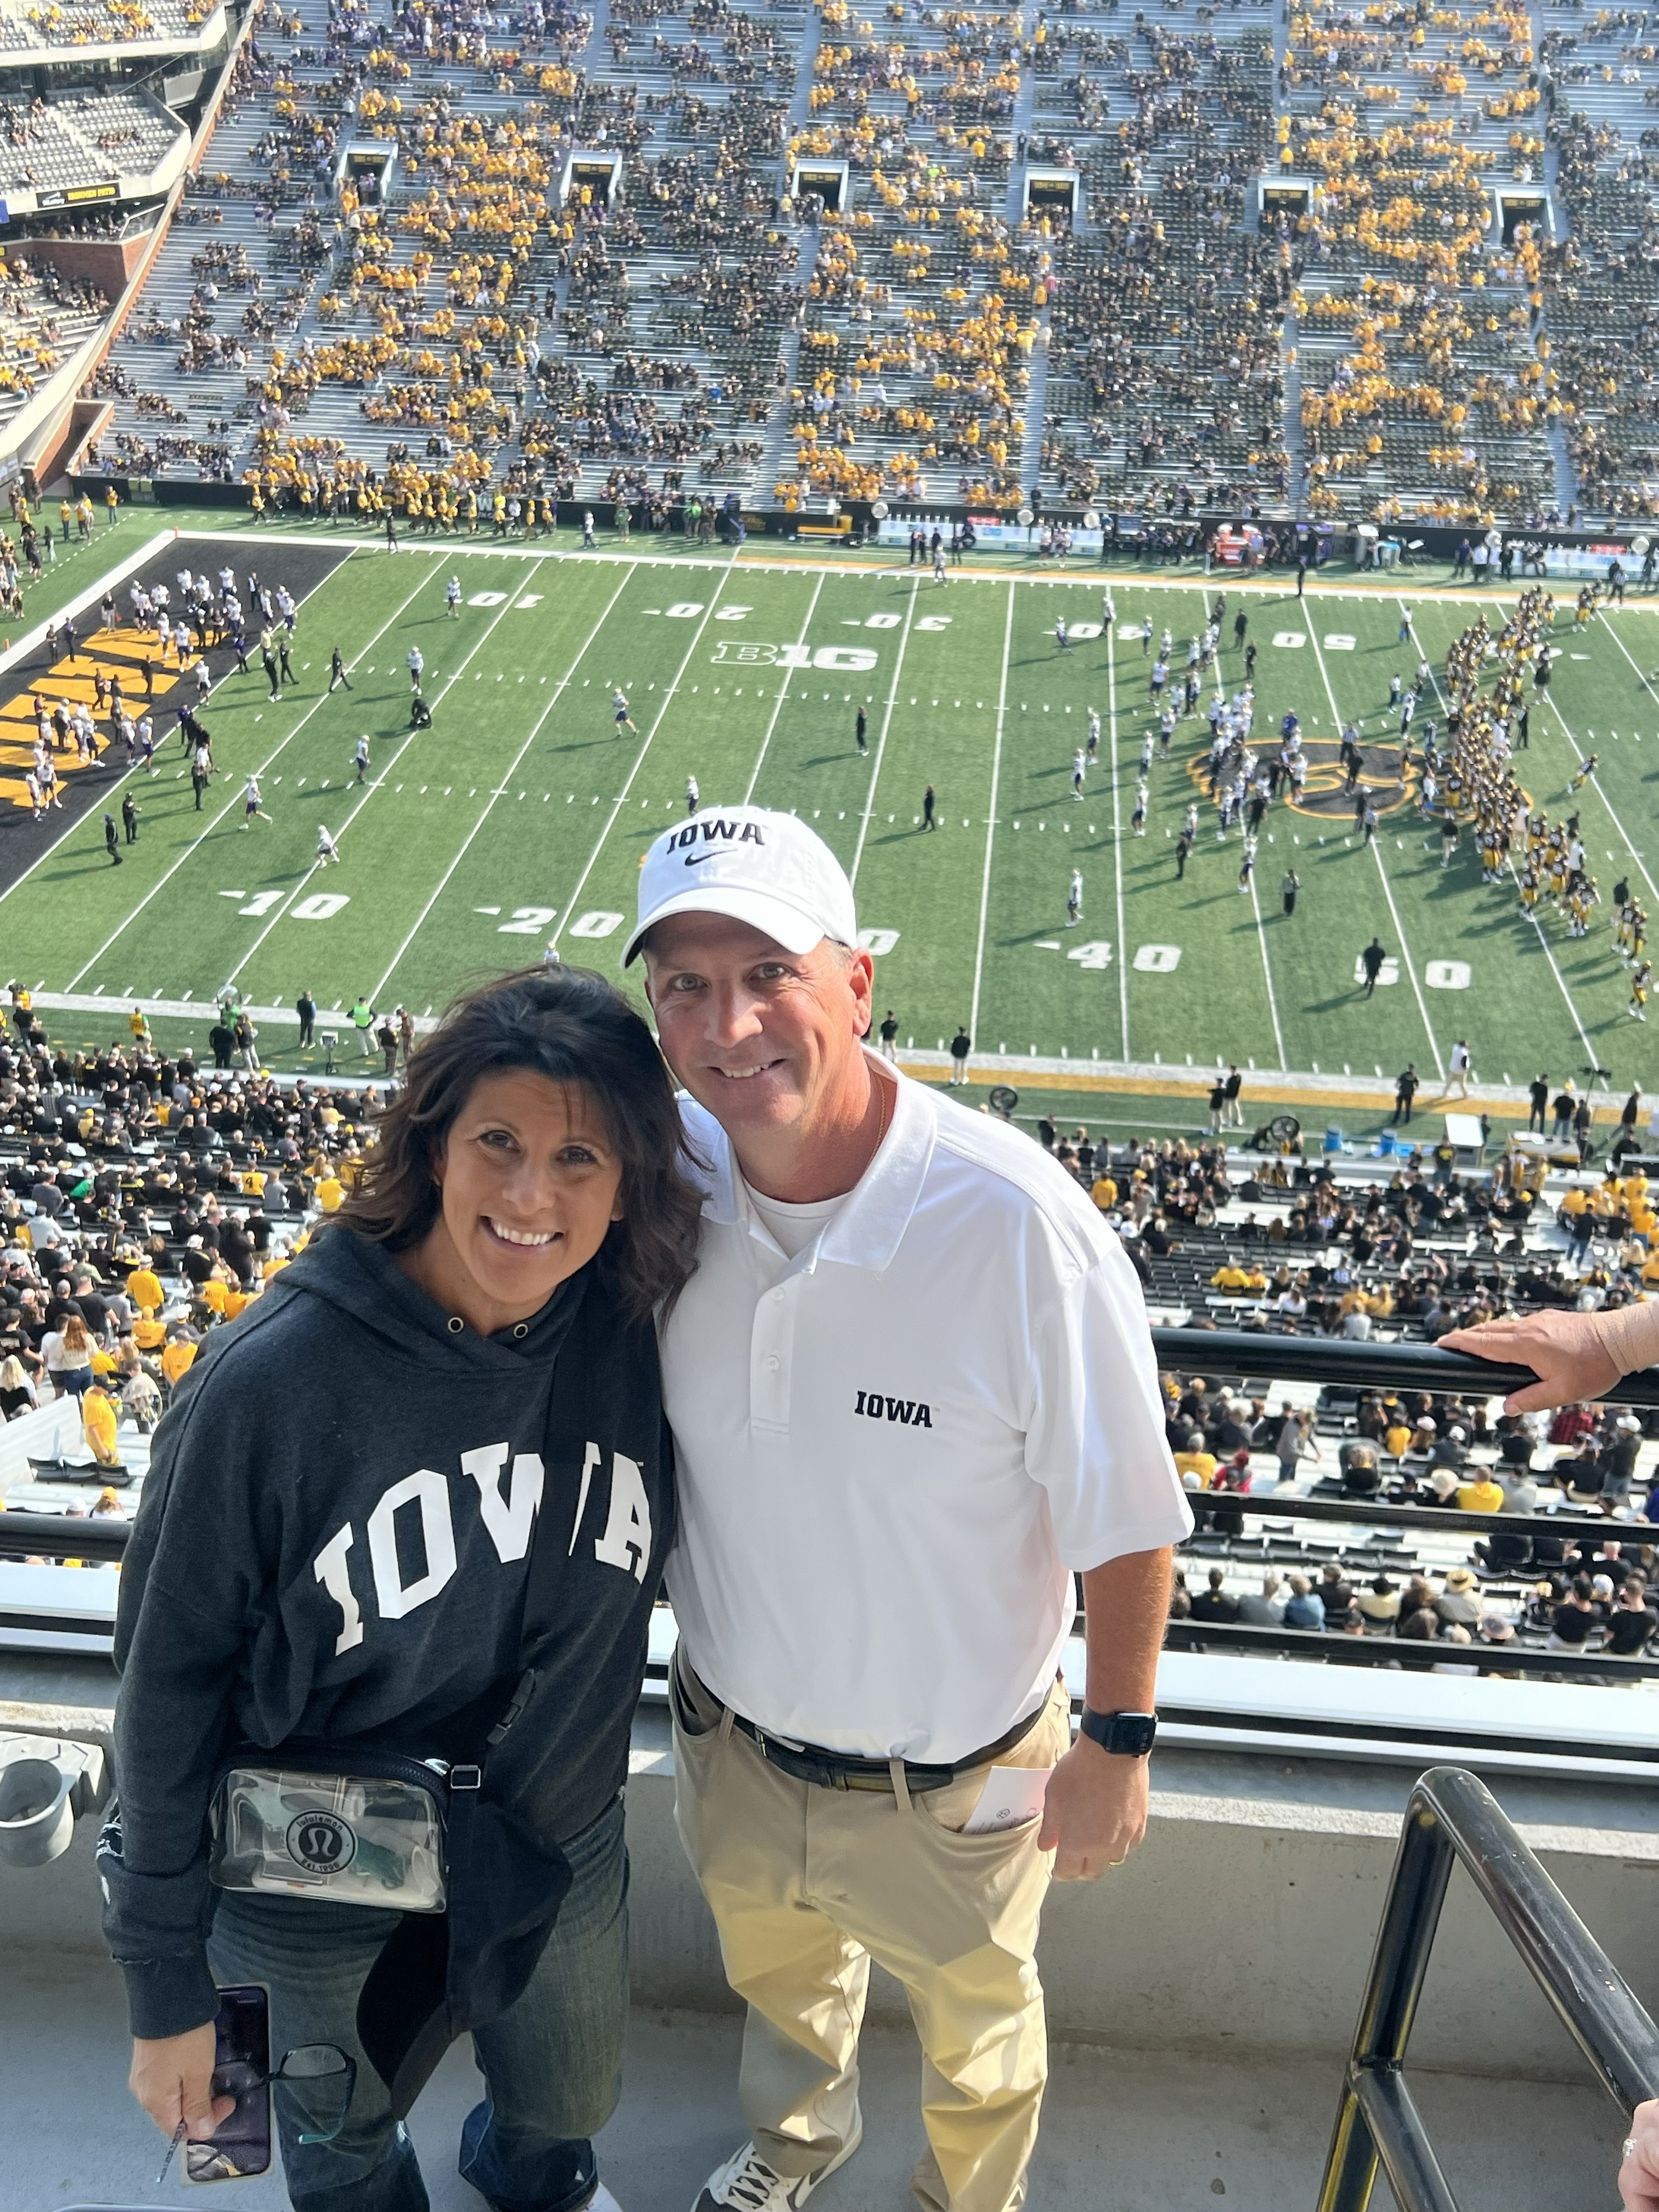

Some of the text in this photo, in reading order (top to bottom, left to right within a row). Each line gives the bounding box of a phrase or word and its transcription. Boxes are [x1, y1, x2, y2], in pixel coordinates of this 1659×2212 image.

[666, 819, 766, 855] IOWA
[238, 890, 351, 919] 10
[497, 907, 625, 938] 20
[1068, 941, 1182, 972] 40
[854, 1390, 933, 1428] IOWA
[296, 1814, 343, 1831] lululemon
